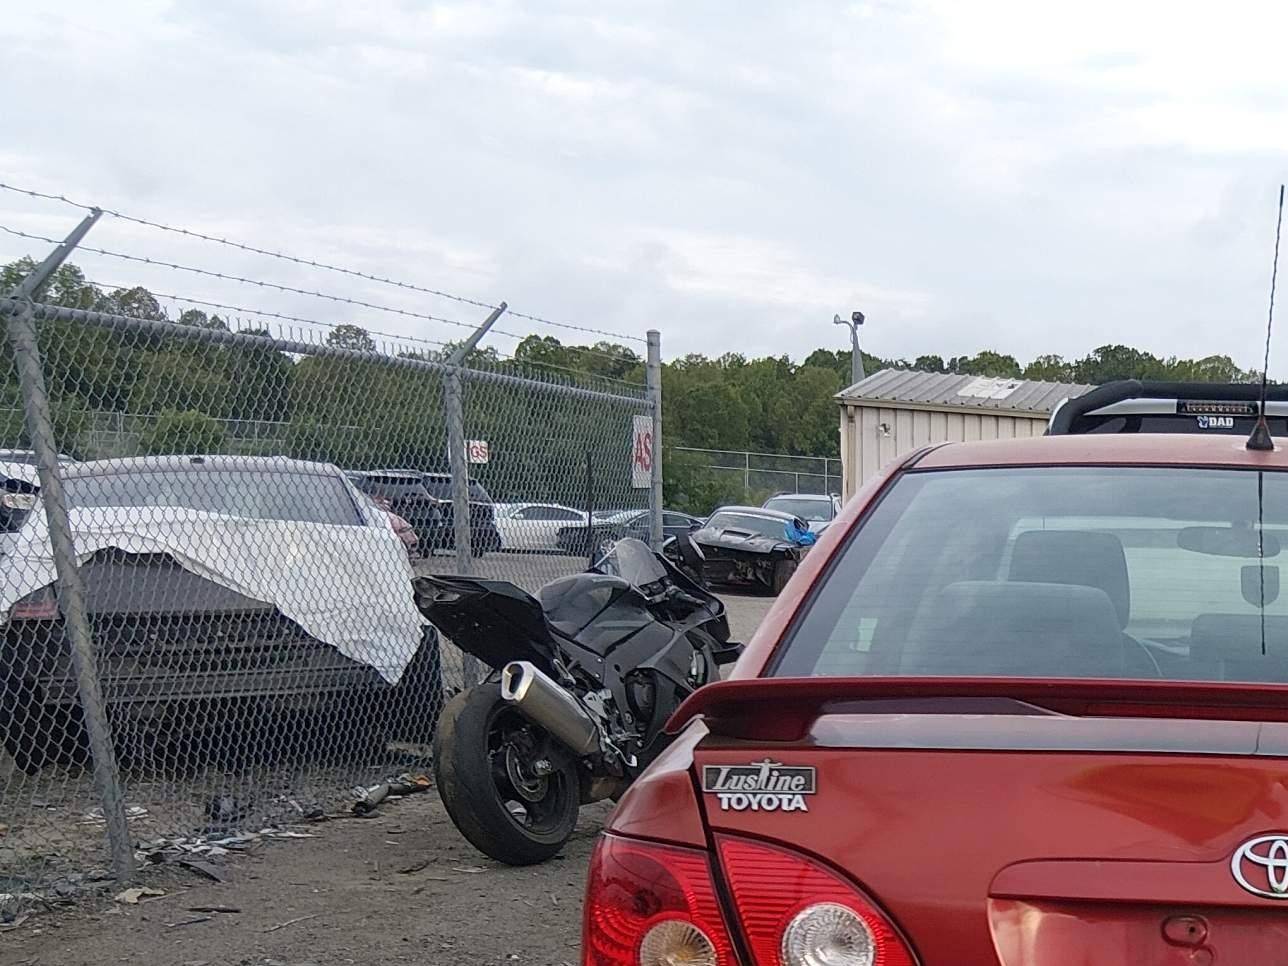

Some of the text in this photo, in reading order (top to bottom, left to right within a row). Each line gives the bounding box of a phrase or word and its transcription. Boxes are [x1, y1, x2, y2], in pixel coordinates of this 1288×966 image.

[1208, 416, 1234, 427] DAD
[711, 759, 806, 791] Lustine
[716, 793, 809, 812] TOYOTA
